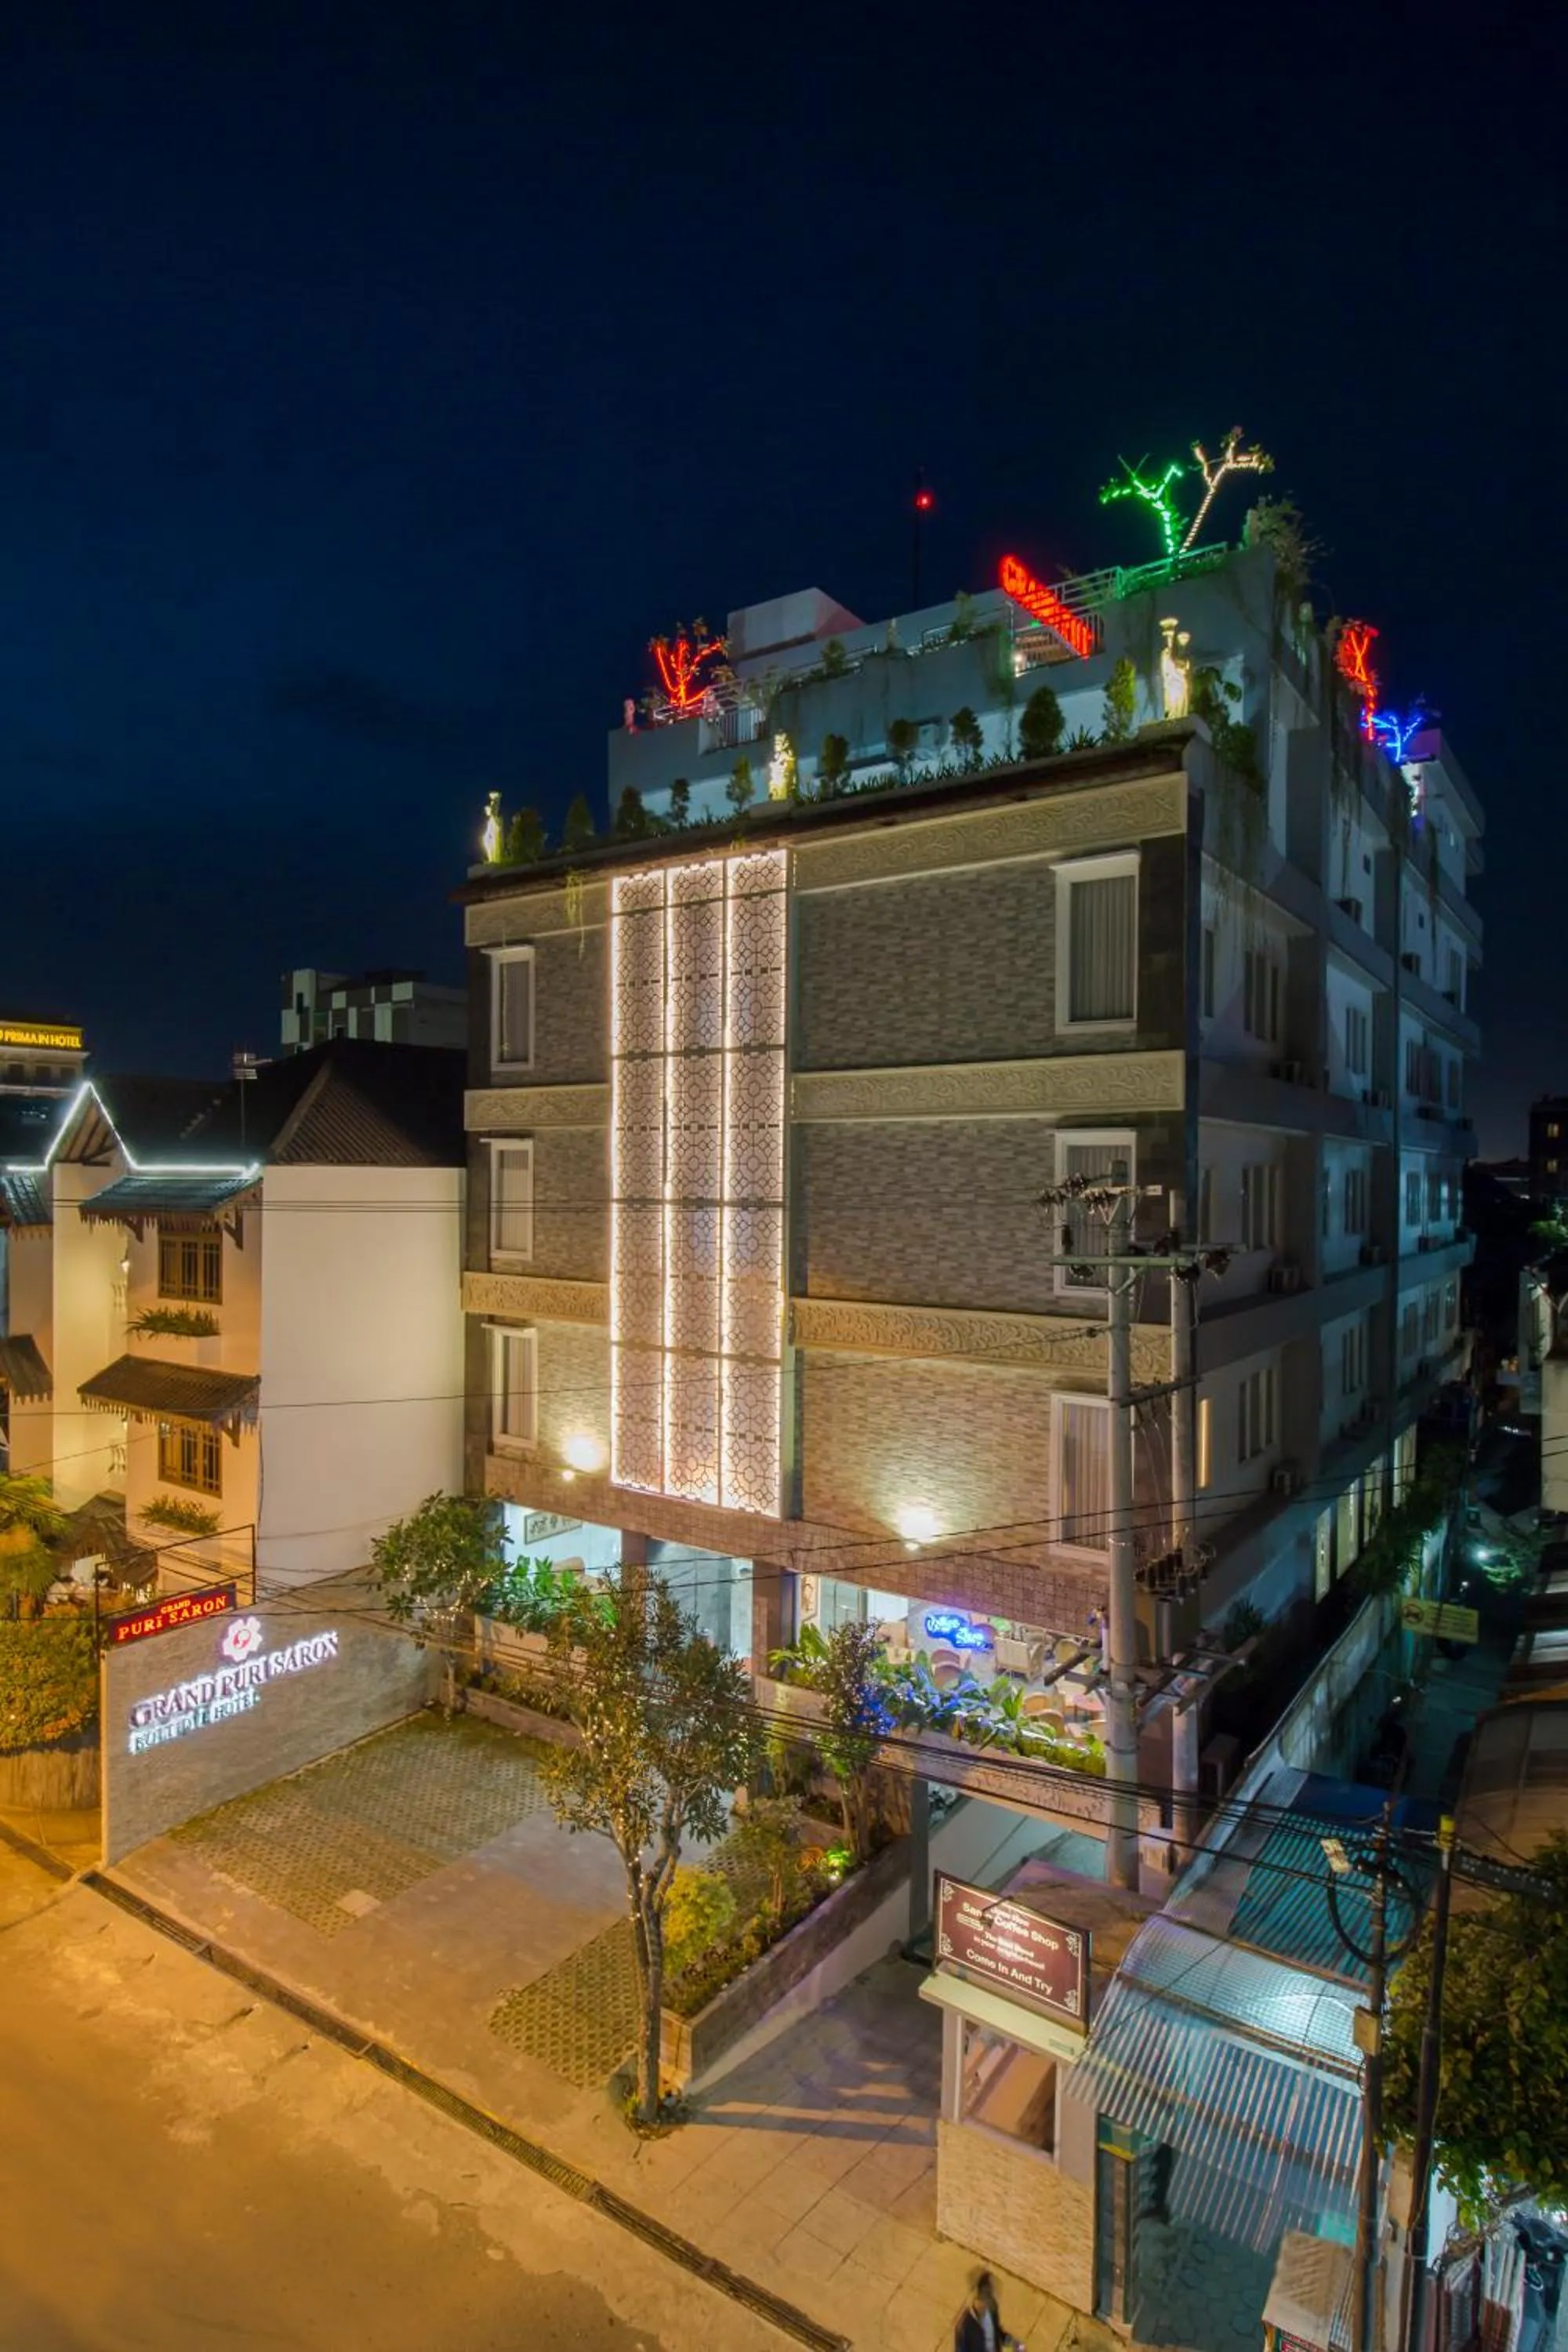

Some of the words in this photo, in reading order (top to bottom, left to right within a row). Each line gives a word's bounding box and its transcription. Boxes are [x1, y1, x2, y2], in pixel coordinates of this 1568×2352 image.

[50, 1033, 82, 1048] HOTEL
[118, 1616, 163, 1640] PURI
[169, 1596, 226, 1624] SARON
[129, 1679, 216, 1728] GRAND
[220, 1657, 270, 1696] PURI
[272, 1632, 339, 1674] SARON
[212, 1688, 261, 1722] HOTEL
[993, 1914, 1029, 1937] Coffee
[1031, 1930, 1059, 1951] Shop
[966, 1948, 996, 1969] Come
[998, 1962, 1009, 1975] In
[1010, 1968, 1033, 1985] And
[1034, 1976, 1054, 1995] Try
